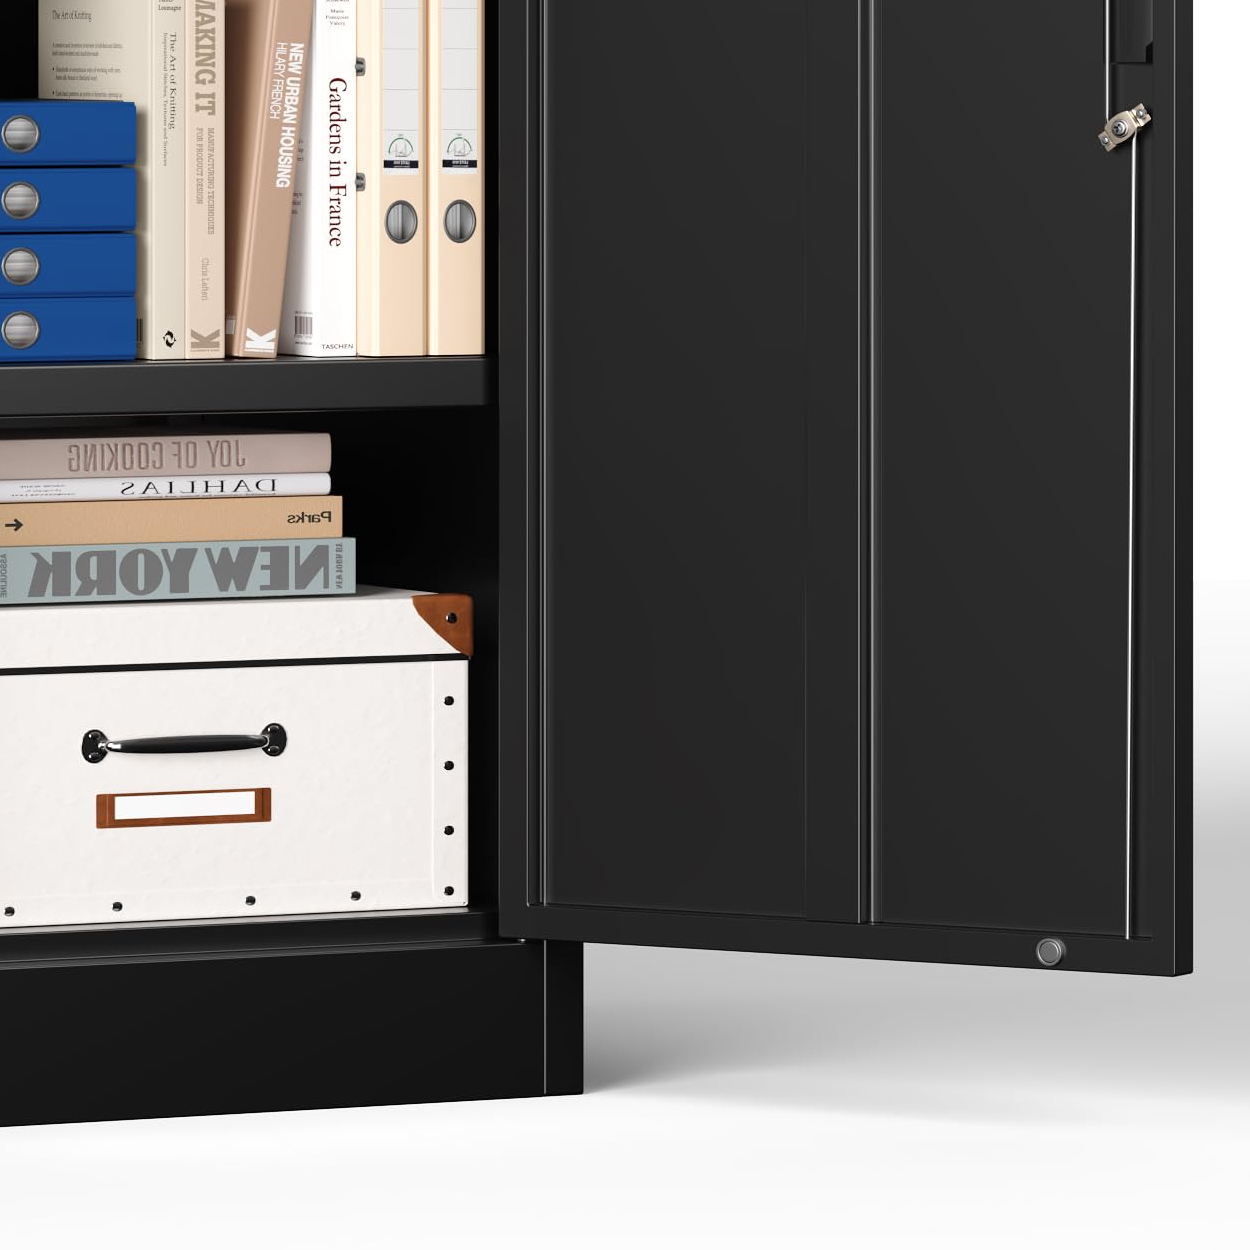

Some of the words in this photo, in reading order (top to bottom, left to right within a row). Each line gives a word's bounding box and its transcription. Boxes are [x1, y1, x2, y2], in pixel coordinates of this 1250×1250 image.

[52, 9, 61, 20] The
[74, 9, 92, 23] Knitting
[169, 32, 177, 52] The
[288, 42, 305, 74] NEW
[169, 54, 177, 71] Art
[273, 42, 288, 78] HILARY
[169, 74, 177, 85] of
[167, 87, 177, 130] Knitting
[194, 91, 216, 116] IT
[269, 78, 284, 119] FRENCH
[282, 76, 301, 124] URBAN
[328, 77, 348, 155] Gardens
[196, 127, 204, 142] FOR
[196, 144, 204, 177] PRODUCT
[207, 127, 215, 189] MANUFACTURING
[275, 126, 296, 188] HOUSING
[329, 160, 348, 178] in
[196, 178, 204, 205] DESIGN
[207, 190, 215, 235] TECHNIQUES
[329, 184, 347, 247] France
[201, 257, 210, 277] Chris
